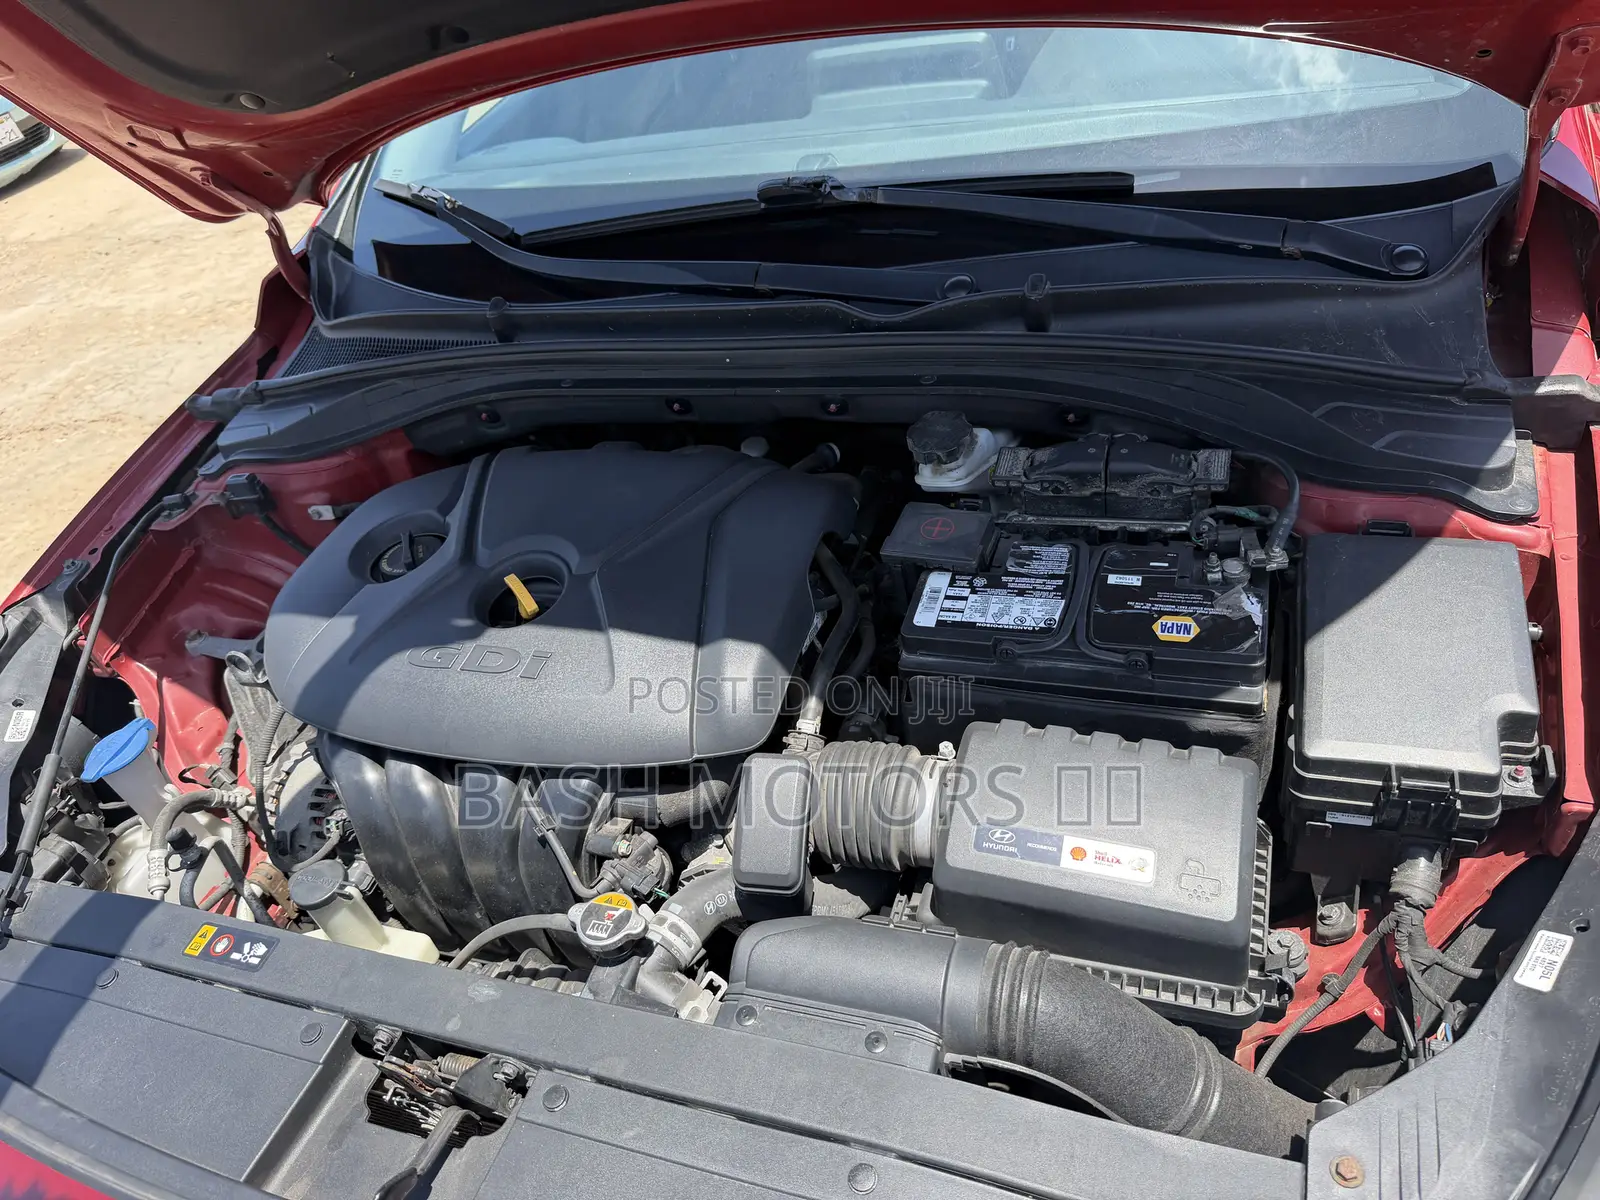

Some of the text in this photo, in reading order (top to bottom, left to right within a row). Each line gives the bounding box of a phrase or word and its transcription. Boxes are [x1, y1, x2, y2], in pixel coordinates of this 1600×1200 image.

[1160, 621, 1192, 636] NAPA
[405, 643, 553, 680] GDi
[982, 841, 1018, 853] HYUNDAI
[1094, 855, 1123, 865] HELIX
[1538, 958, 1559, 981] N05L
